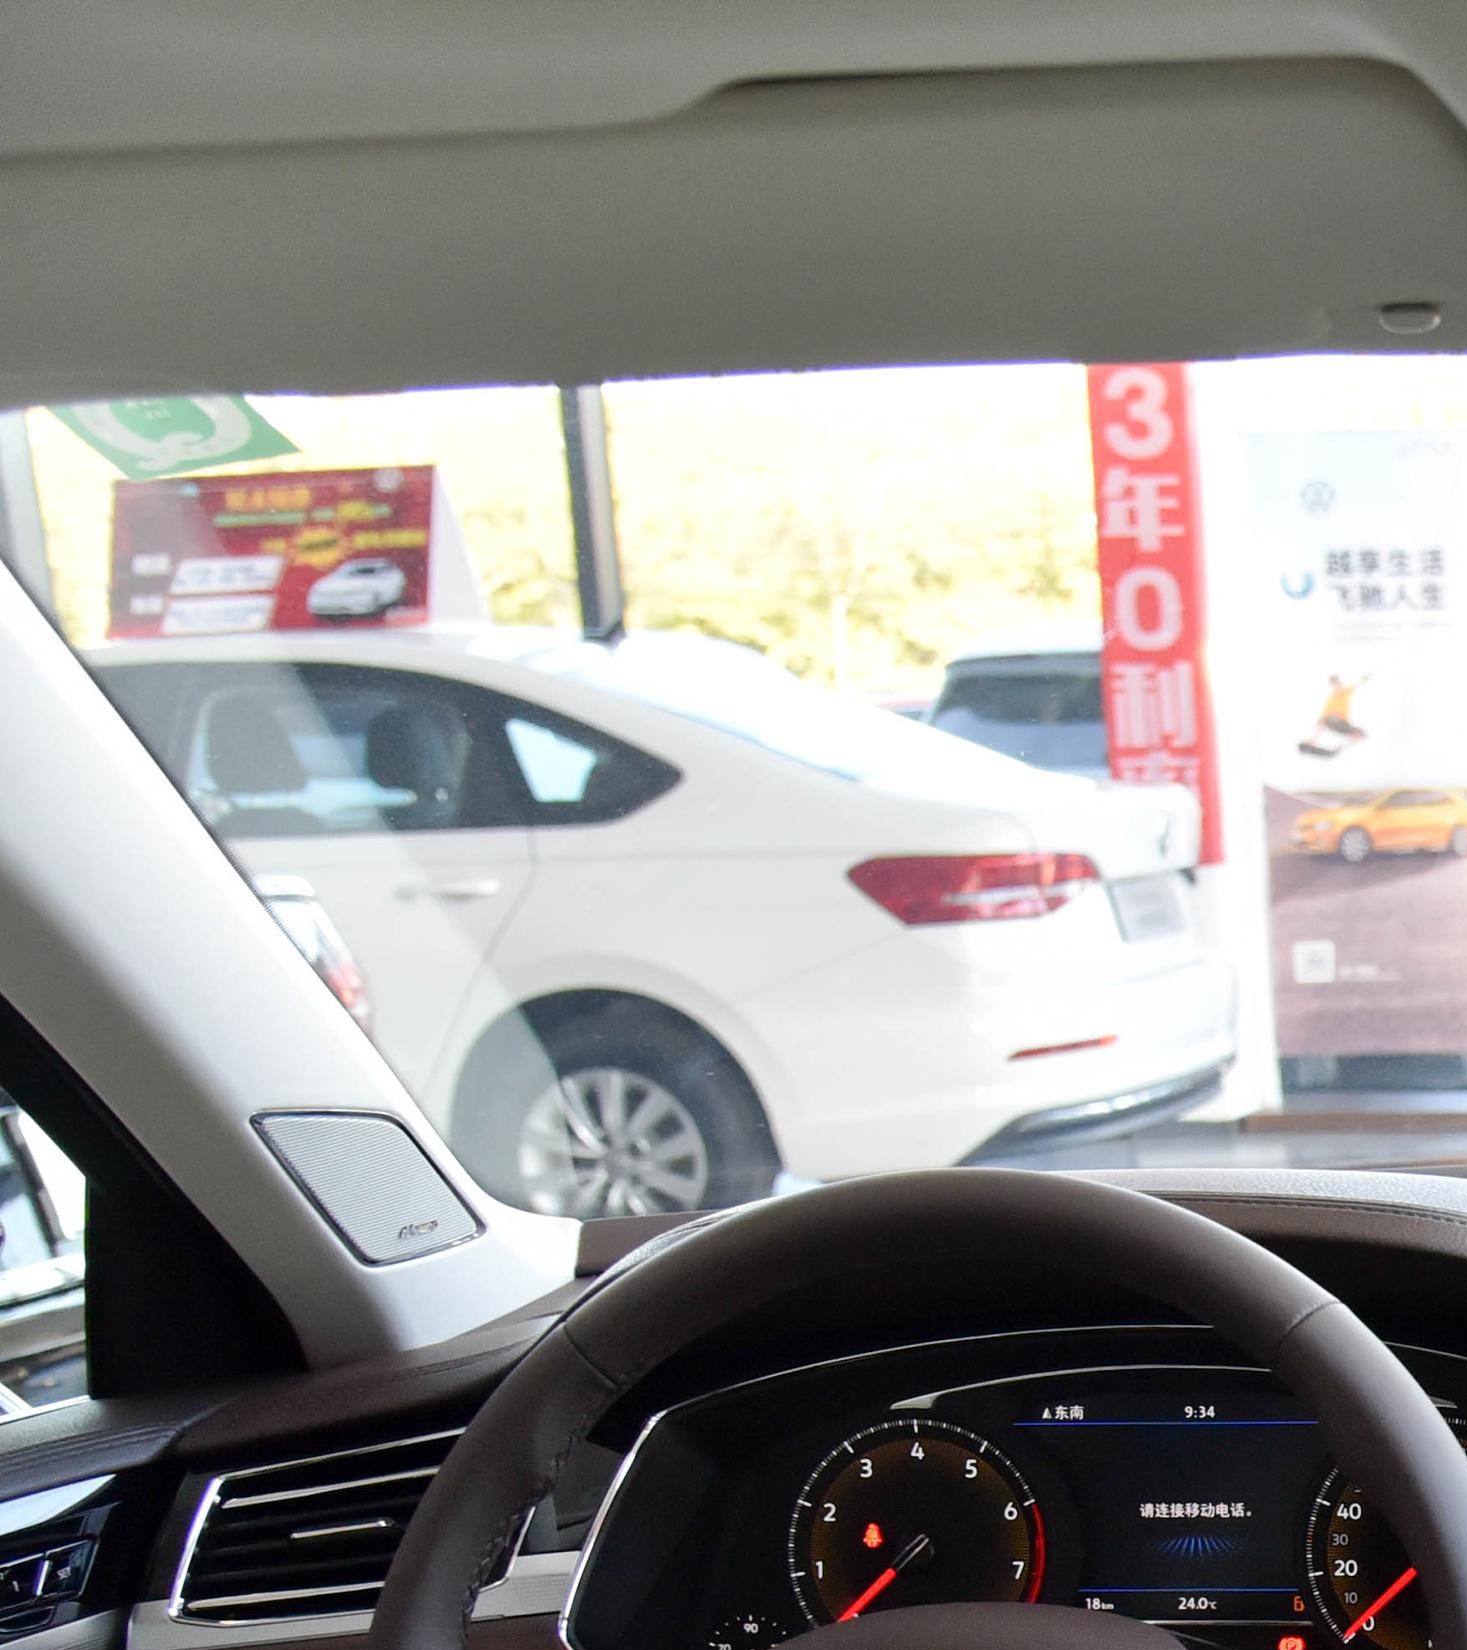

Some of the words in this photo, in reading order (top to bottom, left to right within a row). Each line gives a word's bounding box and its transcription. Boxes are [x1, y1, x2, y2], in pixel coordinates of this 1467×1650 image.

[1054, 1405, 1084, 1421] 东南
[1184, 1406, 1216, 1419] 9:34
[910, 1442, 925, 1460] 4
[860, 1459, 873, 1478] 3
[965, 1459, 978, 1478] 5
[823, 1503, 837, 1522] 2
[1003, 1502, 1018, 1520] 6
[1140, 1502, 1252, 1518] 请连接移动电话。
[1336, 1503, 1362, 1520] 40
[1333, 1533, 1349, 1547] 30
[815, 1561, 823, 1579] 1
[1012, 1561, 1025, 1580] 7
[1334, 1560, 1358, 1577] 20
[1344, 1591, 1358, 1604] 10
[743, 1623, 759, 1634] 90
